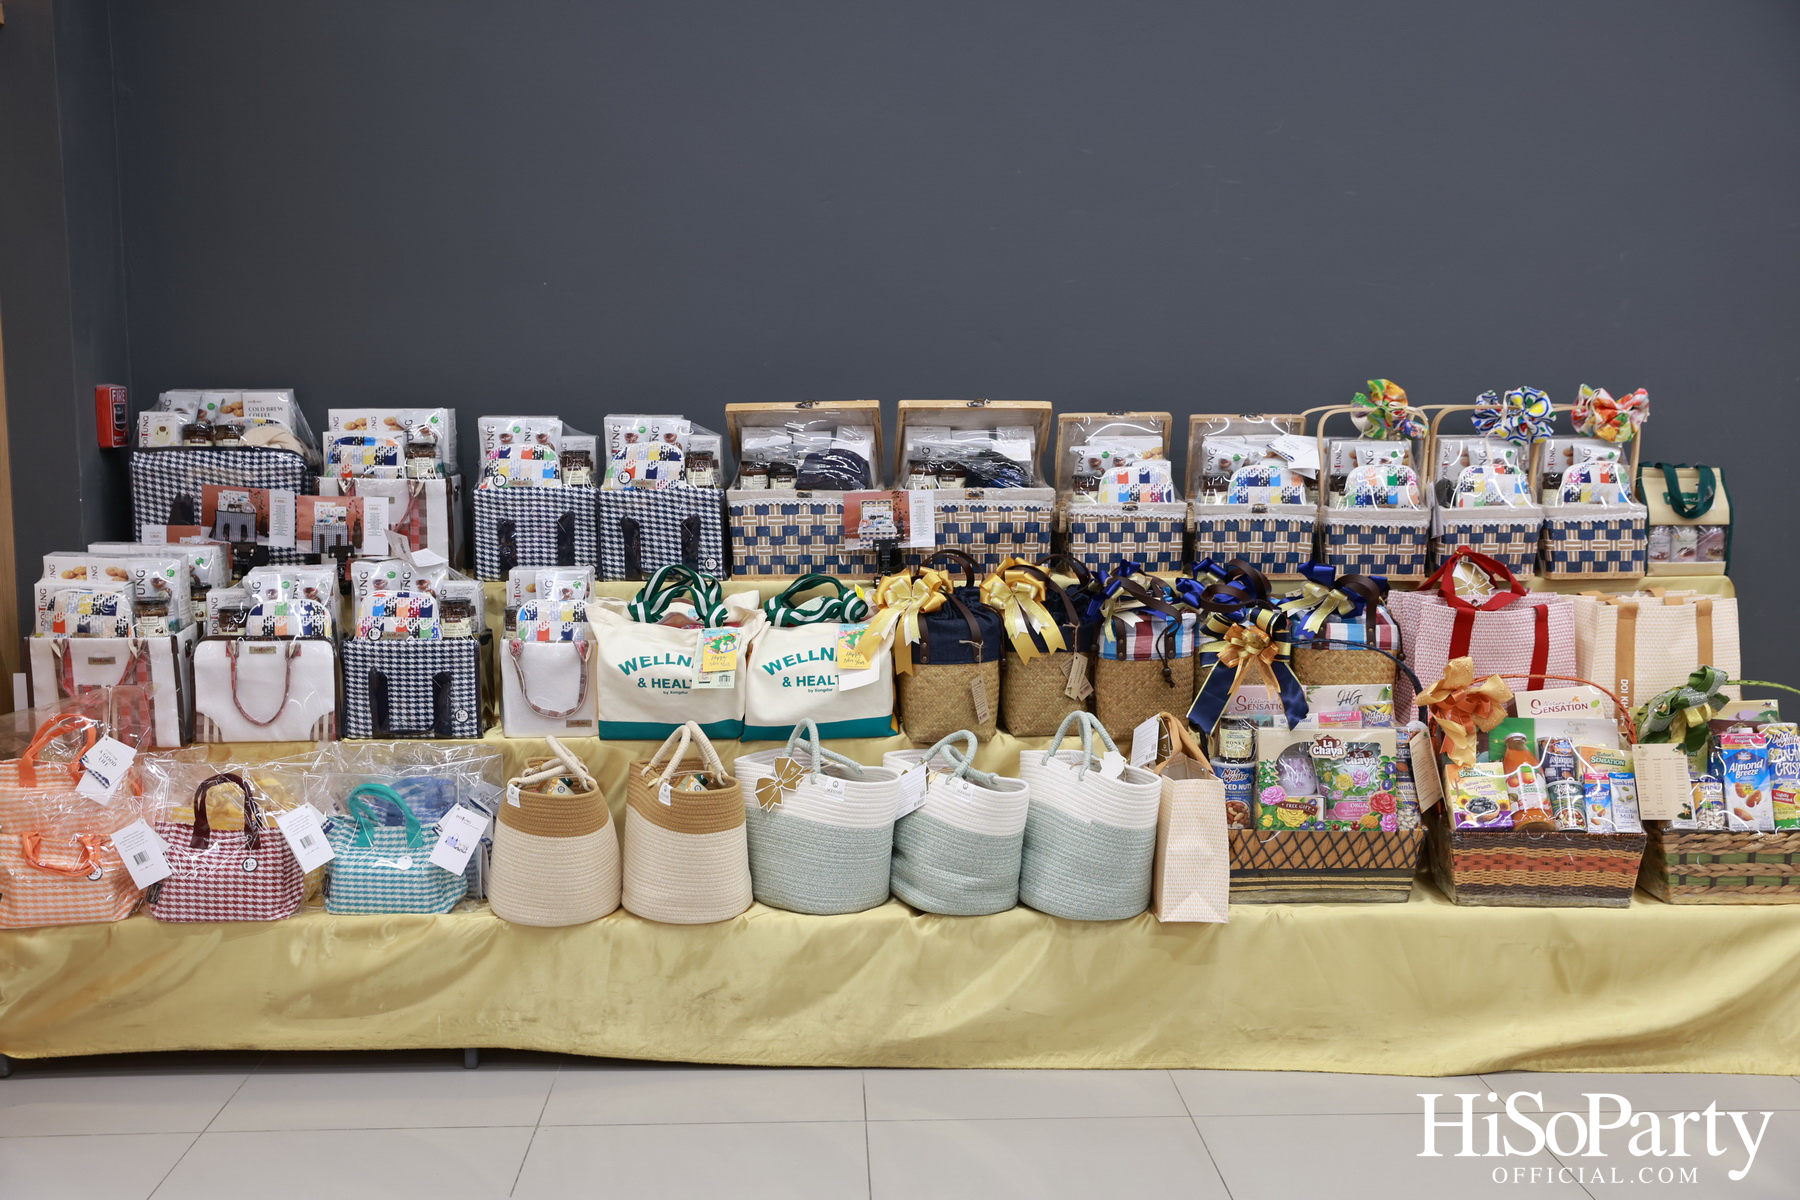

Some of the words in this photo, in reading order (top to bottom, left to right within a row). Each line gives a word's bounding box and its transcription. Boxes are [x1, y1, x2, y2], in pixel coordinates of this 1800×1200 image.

[111, 390, 126, 402] FIRE
[618, 653, 693, 676] WELLN
[762, 647, 838, 676] WELLN
[637, 677, 647, 688] &
[651, 678, 692, 689] HEAL
[782, 676, 792, 688] &
[796, 674, 840, 687] HEAL
[1620, 679, 1629, 694] DOI
[1235, 695, 1283, 712] SENSATIO
[1530, 698, 1589, 716] SENSATION
[1322, 740, 1333, 748] La
[1312, 746, 1343, 758] Chaya
[102, 752, 117, 768] GOOD
[1590, 756, 1626, 767] SENSATION
[1728, 758, 1764, 773] Almond
[1222, 768, 1239, 777] Nut
[1735, 768, 1758, 779] Breeze
